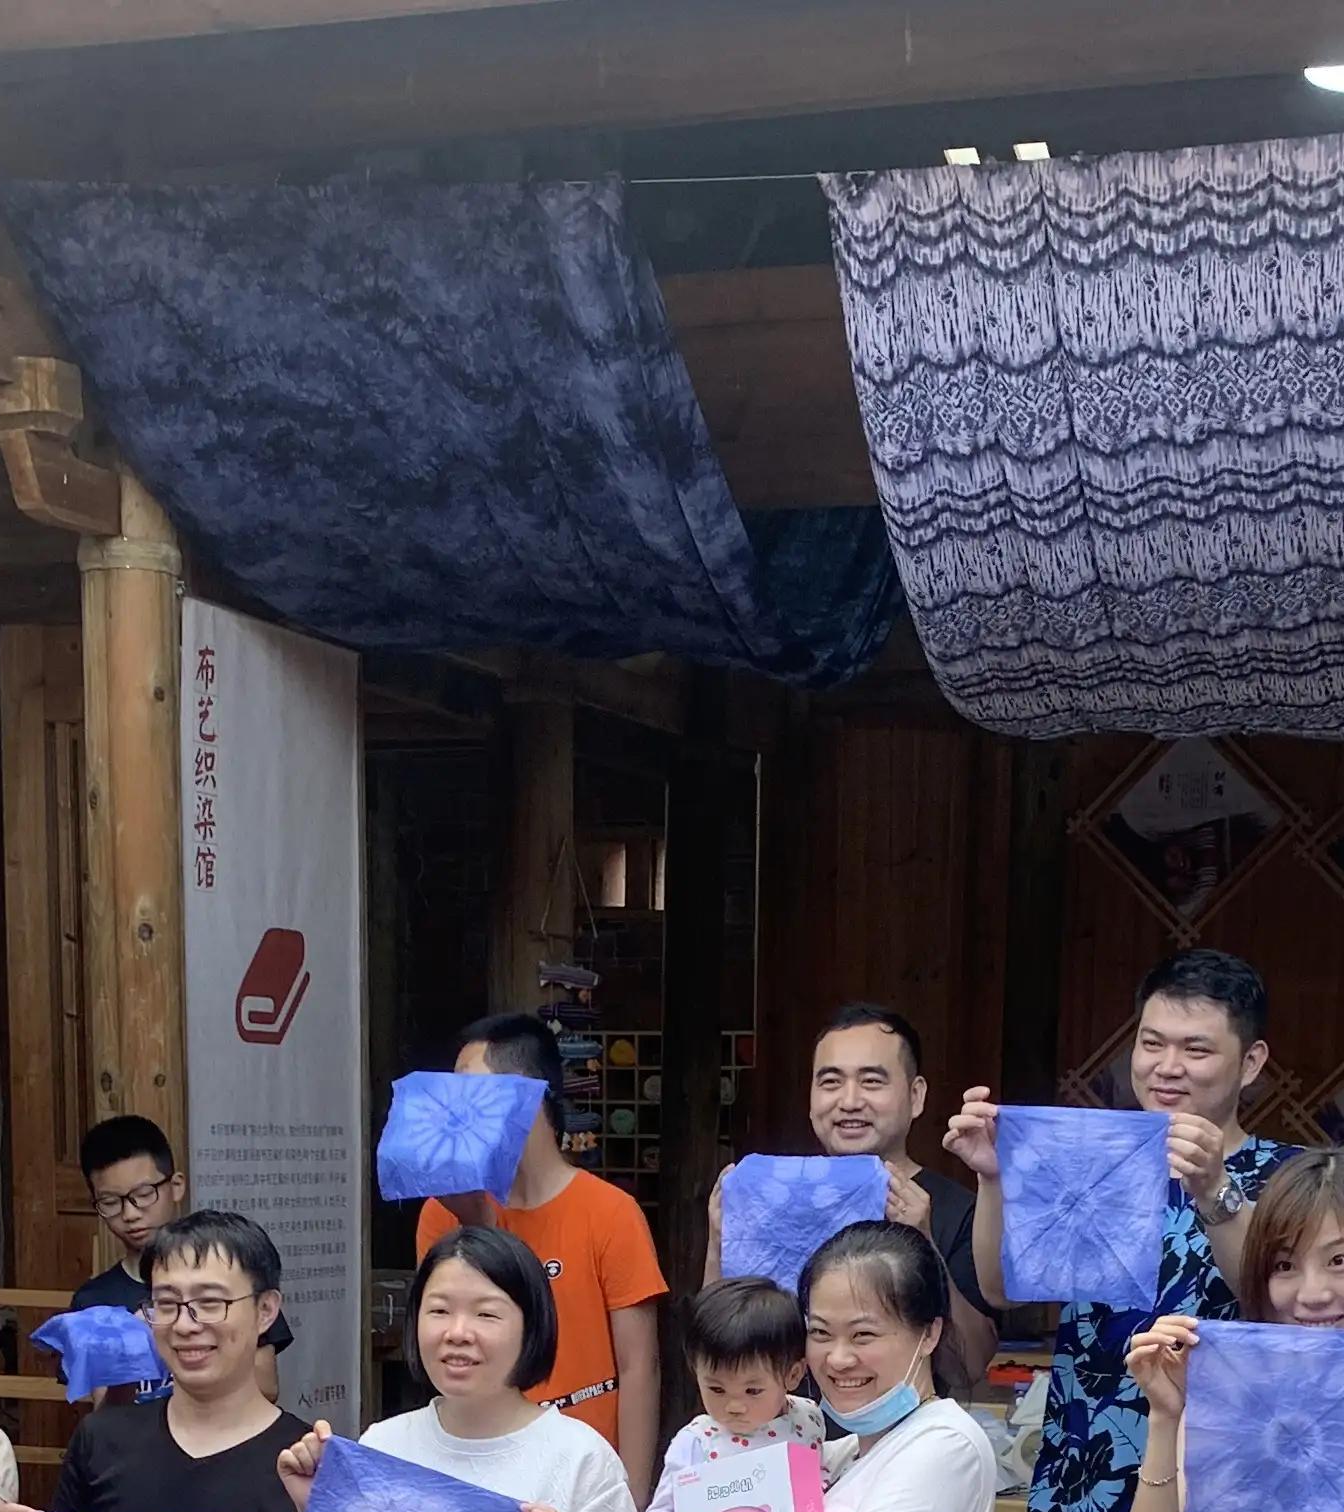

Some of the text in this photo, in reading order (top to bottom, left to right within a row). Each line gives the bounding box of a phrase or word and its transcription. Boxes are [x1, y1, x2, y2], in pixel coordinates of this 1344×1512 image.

[194, 646, 217, 889] 布艺织染馆
